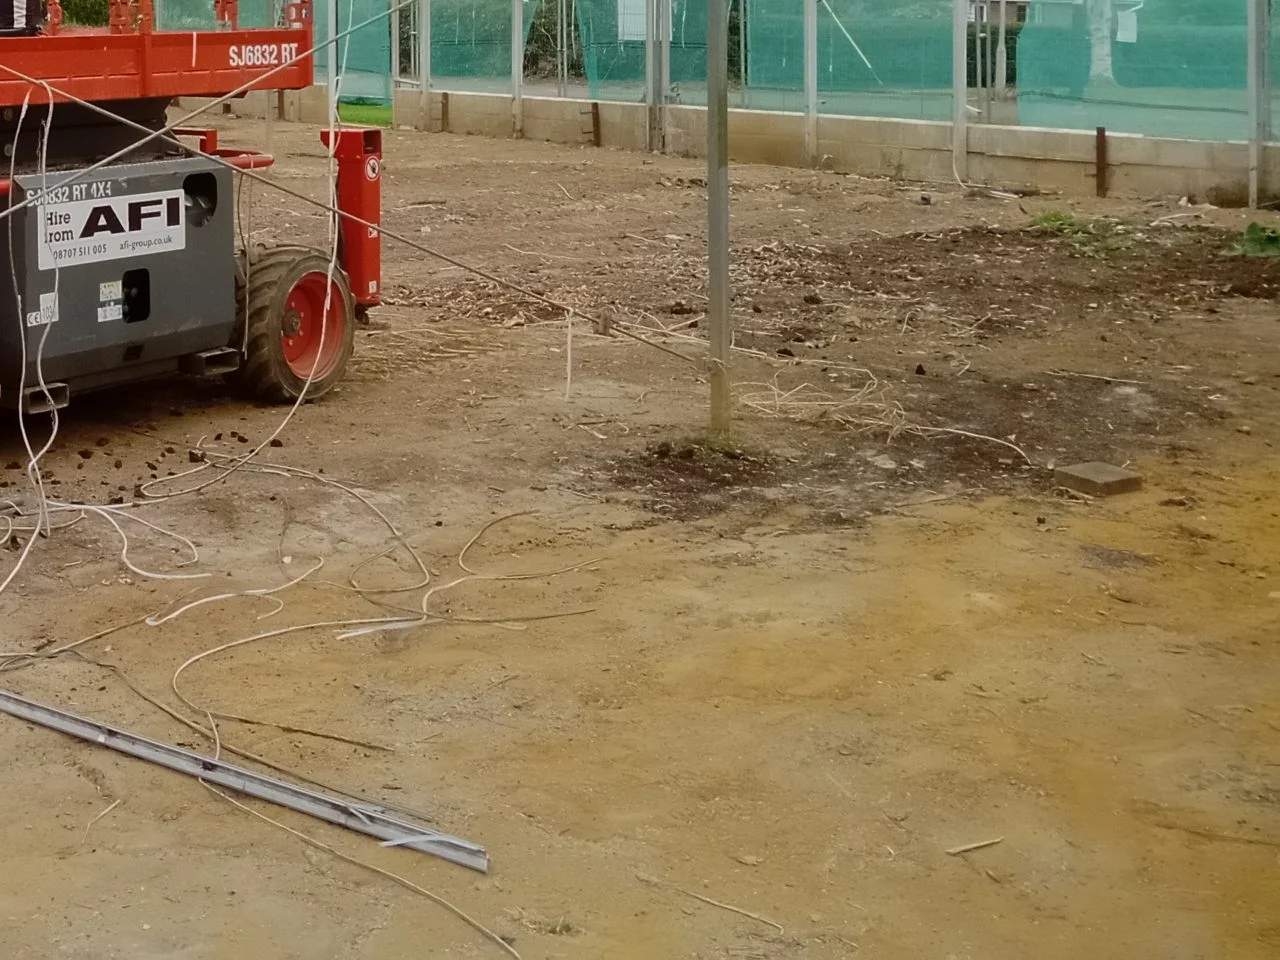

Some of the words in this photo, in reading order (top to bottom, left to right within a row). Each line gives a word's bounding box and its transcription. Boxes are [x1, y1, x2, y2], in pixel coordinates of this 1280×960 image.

[229, 44, 278, 67] SJ6832
[281, 43, 298, 64] RT
[73, 184, 87, 201] RT
[46, 212, 71, 226] Hire
[79, 197, 180, 239] AFI
[119, 235, 173, 251] afi-group.co.uk
[53, 247, 76, 260] 08707
[79, 246, 91, 256] 511
[93, 244, 107, 255] 005
